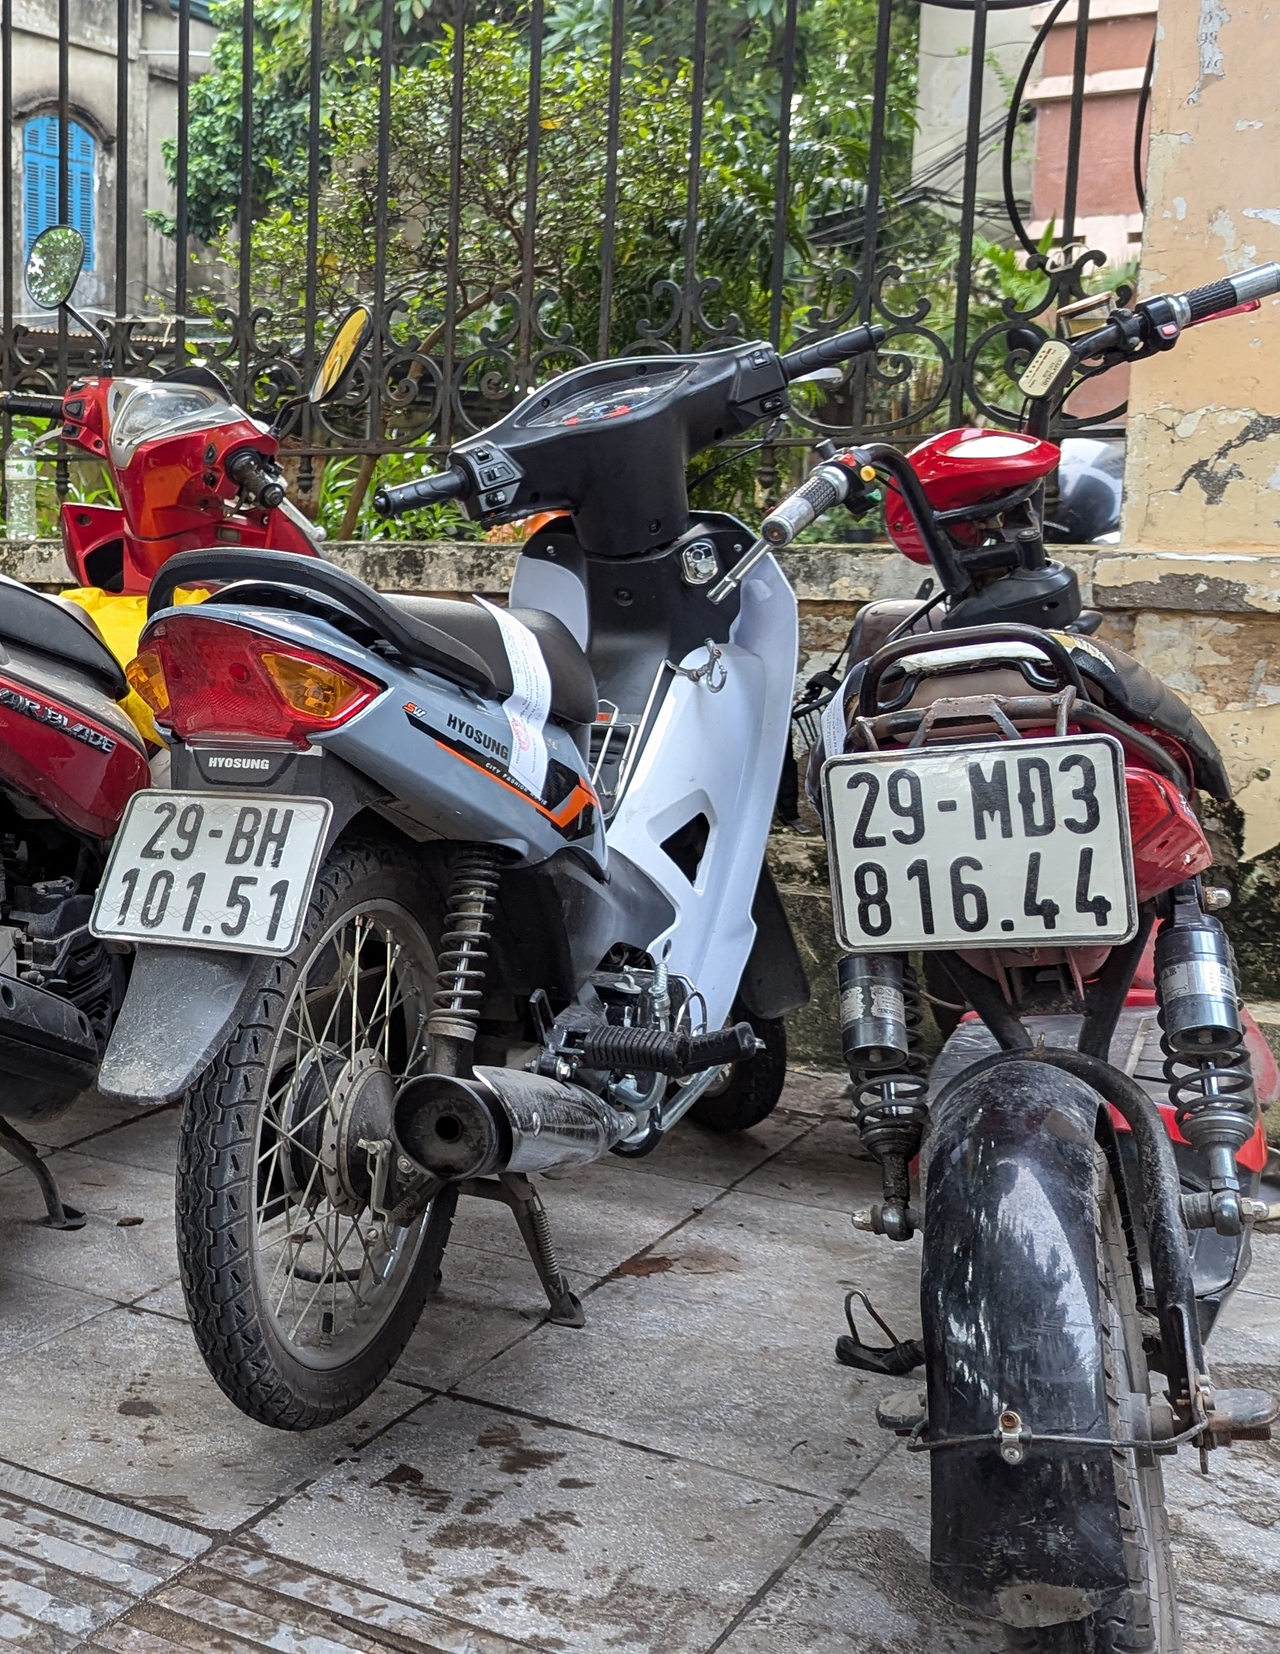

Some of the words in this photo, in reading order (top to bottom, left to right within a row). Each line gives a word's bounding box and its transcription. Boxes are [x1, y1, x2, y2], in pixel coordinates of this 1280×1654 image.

[402, 701, 427, 718] SW
[446, 713, 509, 760] HYOSUNG
[208, 757, 270, 770] HYOSUNG
[485, 762, 501, 774] CITY
[503, 773, 528, 793] FASHION
[846, 754, 1101, 848] 29-MD3
[141, 802, 294, 868] 29-BH
[117, 867, 290, 940] 101.51
[854, 847, 1111, 937] 816.44
